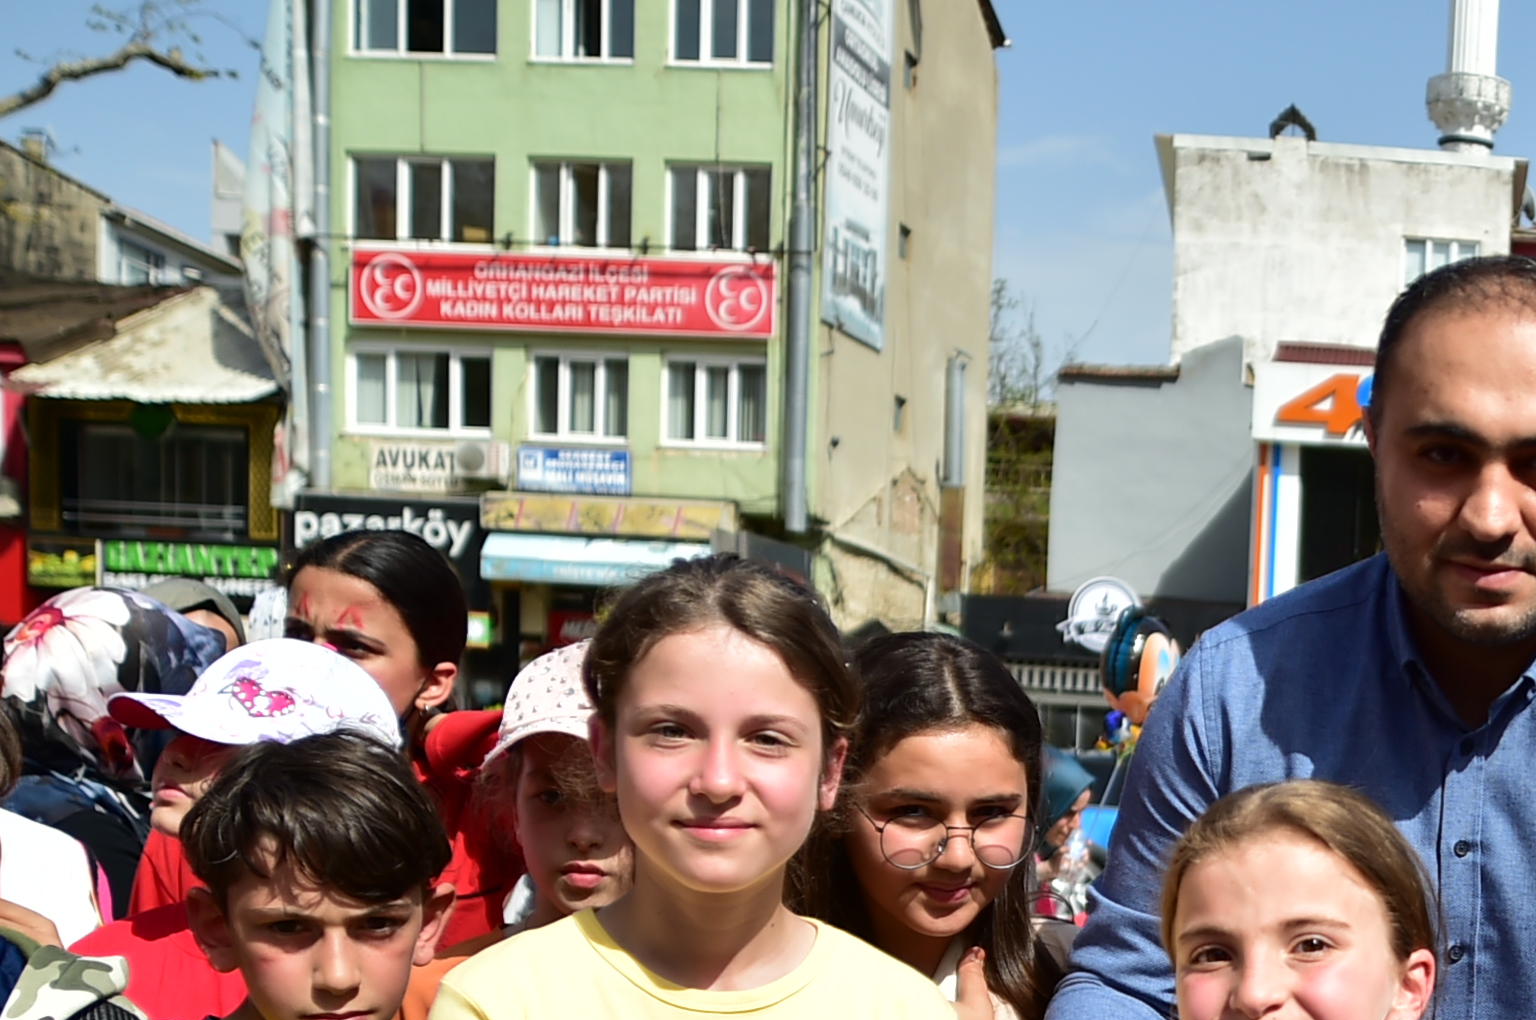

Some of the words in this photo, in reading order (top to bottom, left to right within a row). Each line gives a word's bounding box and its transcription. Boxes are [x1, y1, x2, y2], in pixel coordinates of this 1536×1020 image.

[426, 278, 528, 302] MİLLİYETÇİ
[531, 281, 620, 303] HAREKET
[624, 284, 697, 306] PARTİSİ
[440, 301, 497, 318] KADIN
[502, 303, 584, 321] KOLLARI
[588, 306, 683, 325] TEŞKİLATI
[376, 448, 455, 473] AVUKAT
